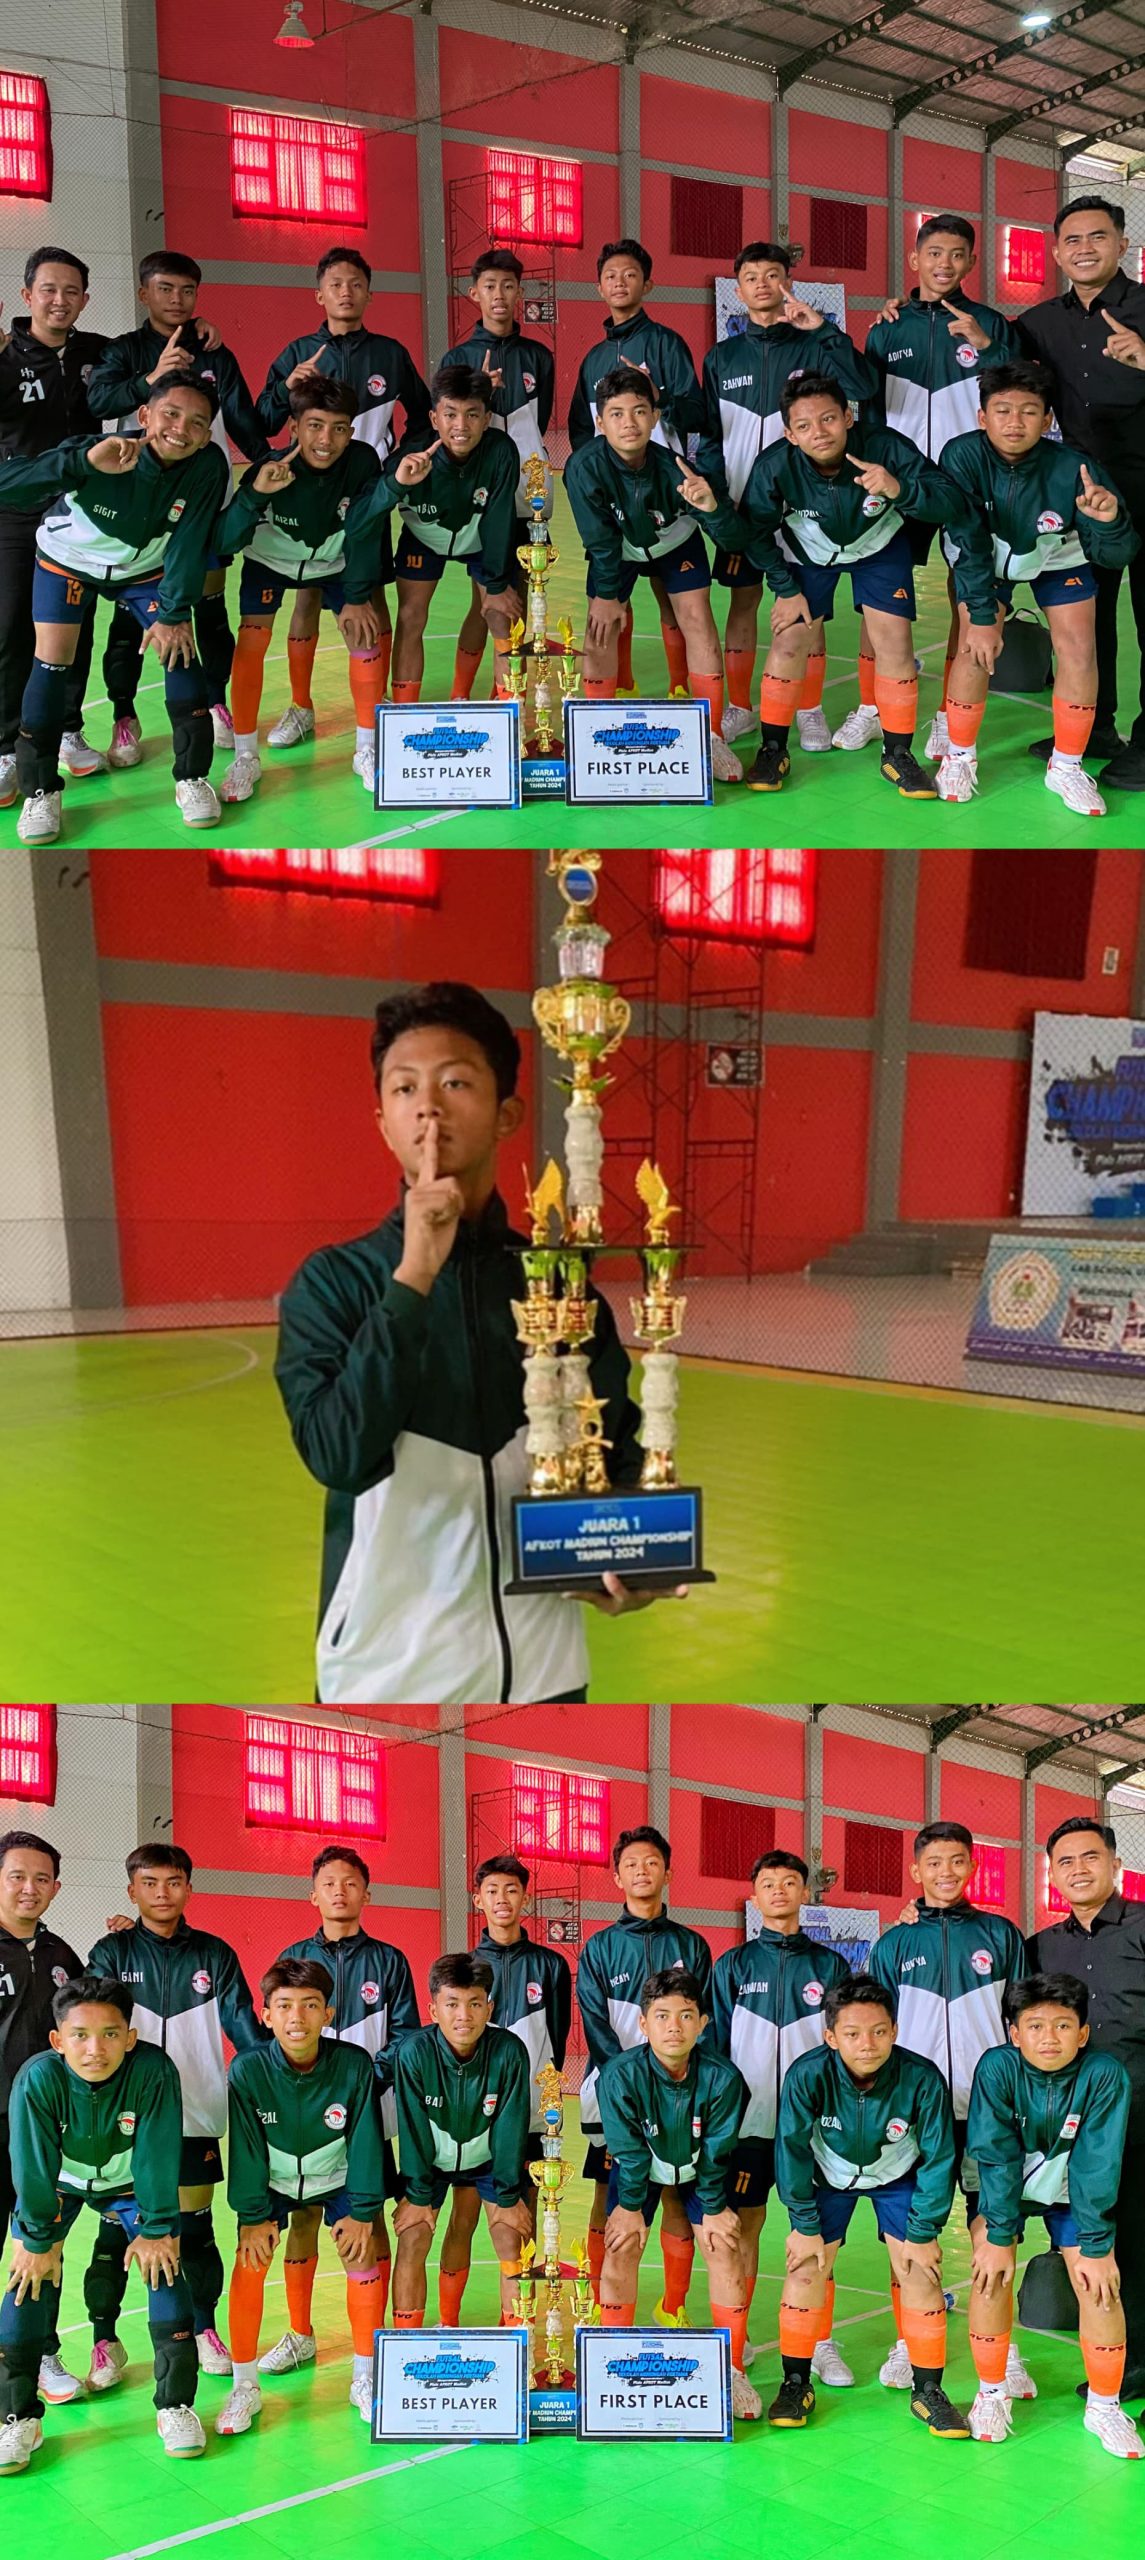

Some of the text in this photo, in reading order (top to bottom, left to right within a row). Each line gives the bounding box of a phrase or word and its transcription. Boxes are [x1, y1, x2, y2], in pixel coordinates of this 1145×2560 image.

[888, 348, 913, 362] ADITYA
[19, 379, 45, 403] 21
[93, 504, 118, 520] SIGIT
[66, 579, 84, 606] 13
[404, 732, 489, 746] CHAMPIONSHIP
[594, 729, 680, 742] CHAMPIONSHIP
[402, 767, 492, 778] BEST PLAYER
[588, 762, 689, 775] FIRST PLACE
[578, 1516, 640, 1533] JUARA 1
[525, 1530, 693, 1551] AFKOT MADIUN CHAMPIONSHIP
[575, 1547, 645, 1561] TAHUN 2024
[121, 1971, 144, 1983] GANI
[735, 2171, 751, 2194] 11
[404, 2361, 496, 2374] CHAMPIONSHIP
[607, 2359, 699, 2372] CHAMPIONSHIP
[402, 2398, 497, 2409] BEST PLAYER
[539, 2401, 564, 2409] JUARA
[600, 2394, 708, 2408] FIRST PLACE
